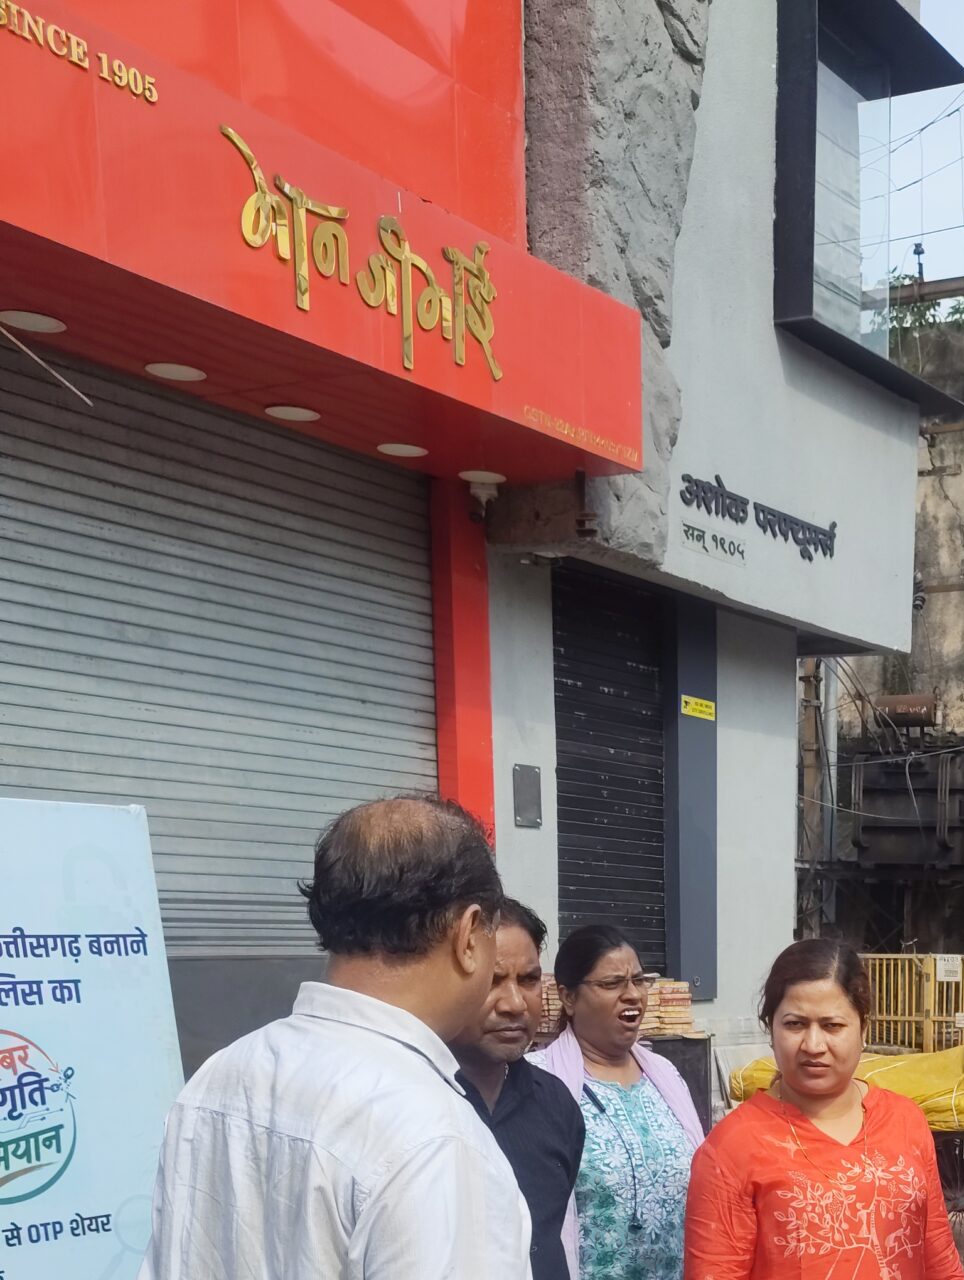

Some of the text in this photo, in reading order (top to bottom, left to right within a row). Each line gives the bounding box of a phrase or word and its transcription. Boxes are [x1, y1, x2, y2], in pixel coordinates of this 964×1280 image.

[97, 52, 159, 103] 1905
[680, 473, 749, 525] अशोक
[682, 523, 745, 560] सन् १९०५
[85, 926, 148, 957] बनाने
[0, 972, 82, 1006] लिस का
[0, 1045, 36, 1076] बर
[0, 1071, 50, 1121] गृति
[2, 1212, 112, 1247] से OTP शेयर
